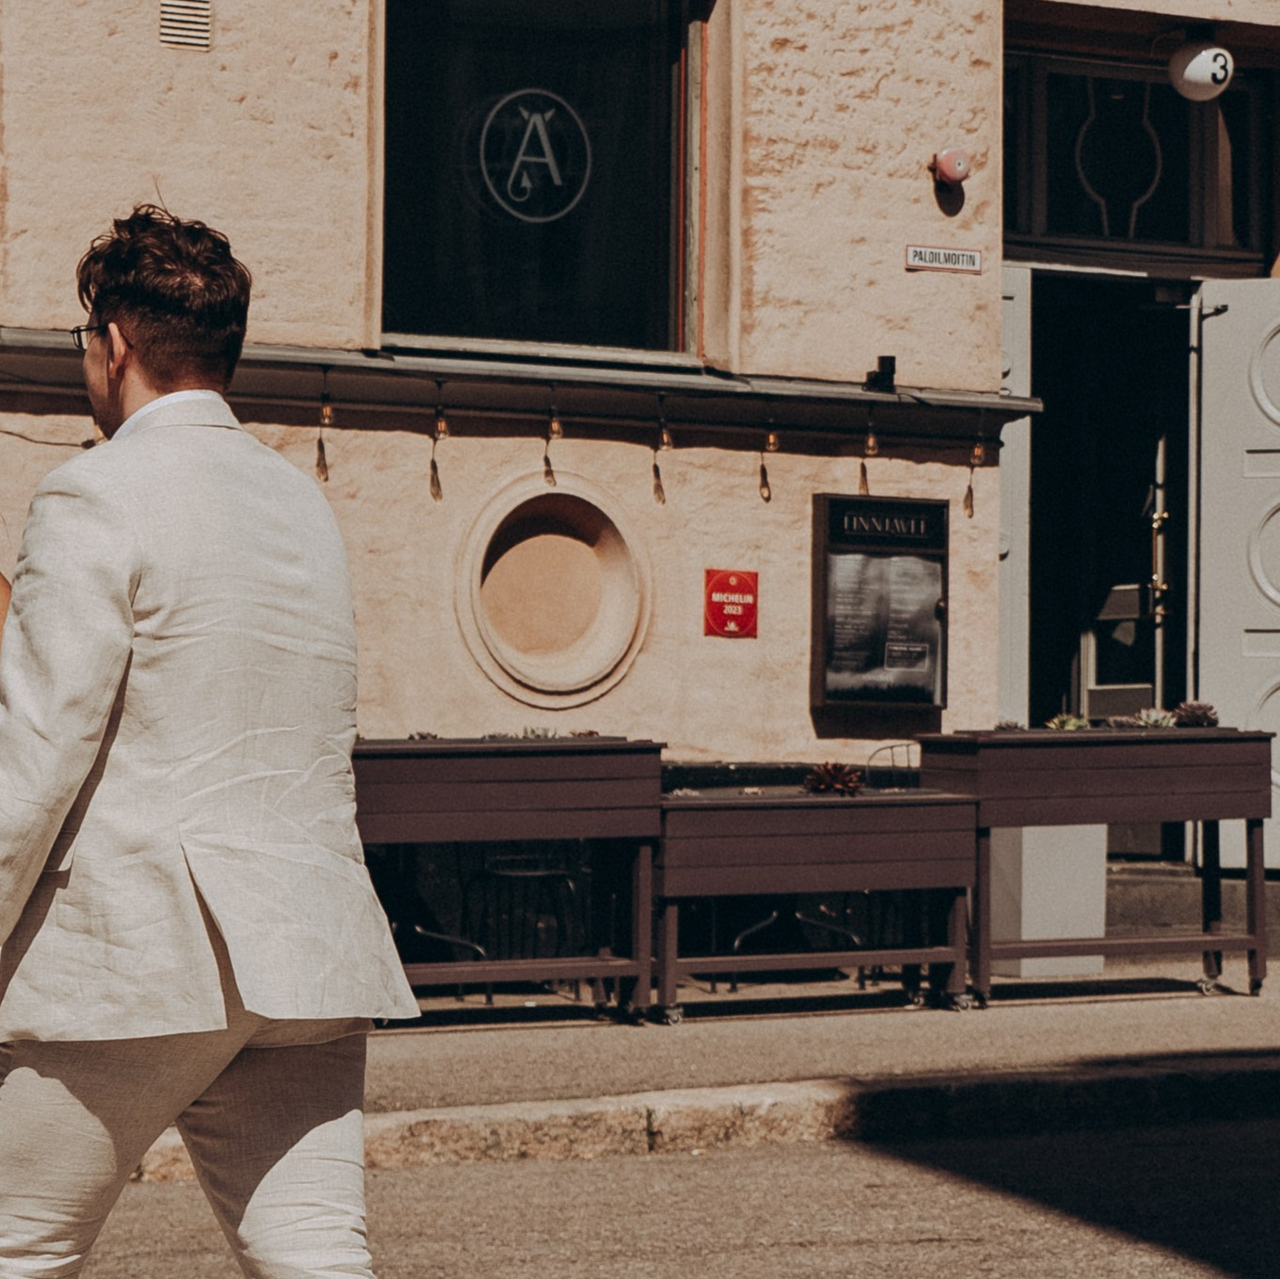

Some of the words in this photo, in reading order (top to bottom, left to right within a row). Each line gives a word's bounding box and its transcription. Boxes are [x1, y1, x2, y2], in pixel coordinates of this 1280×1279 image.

[1211, 52, 1229, 86] 3
[913, 249, 976, 267] PALOILMOITIN
[711, 592, 754, 604] MICHELIN
